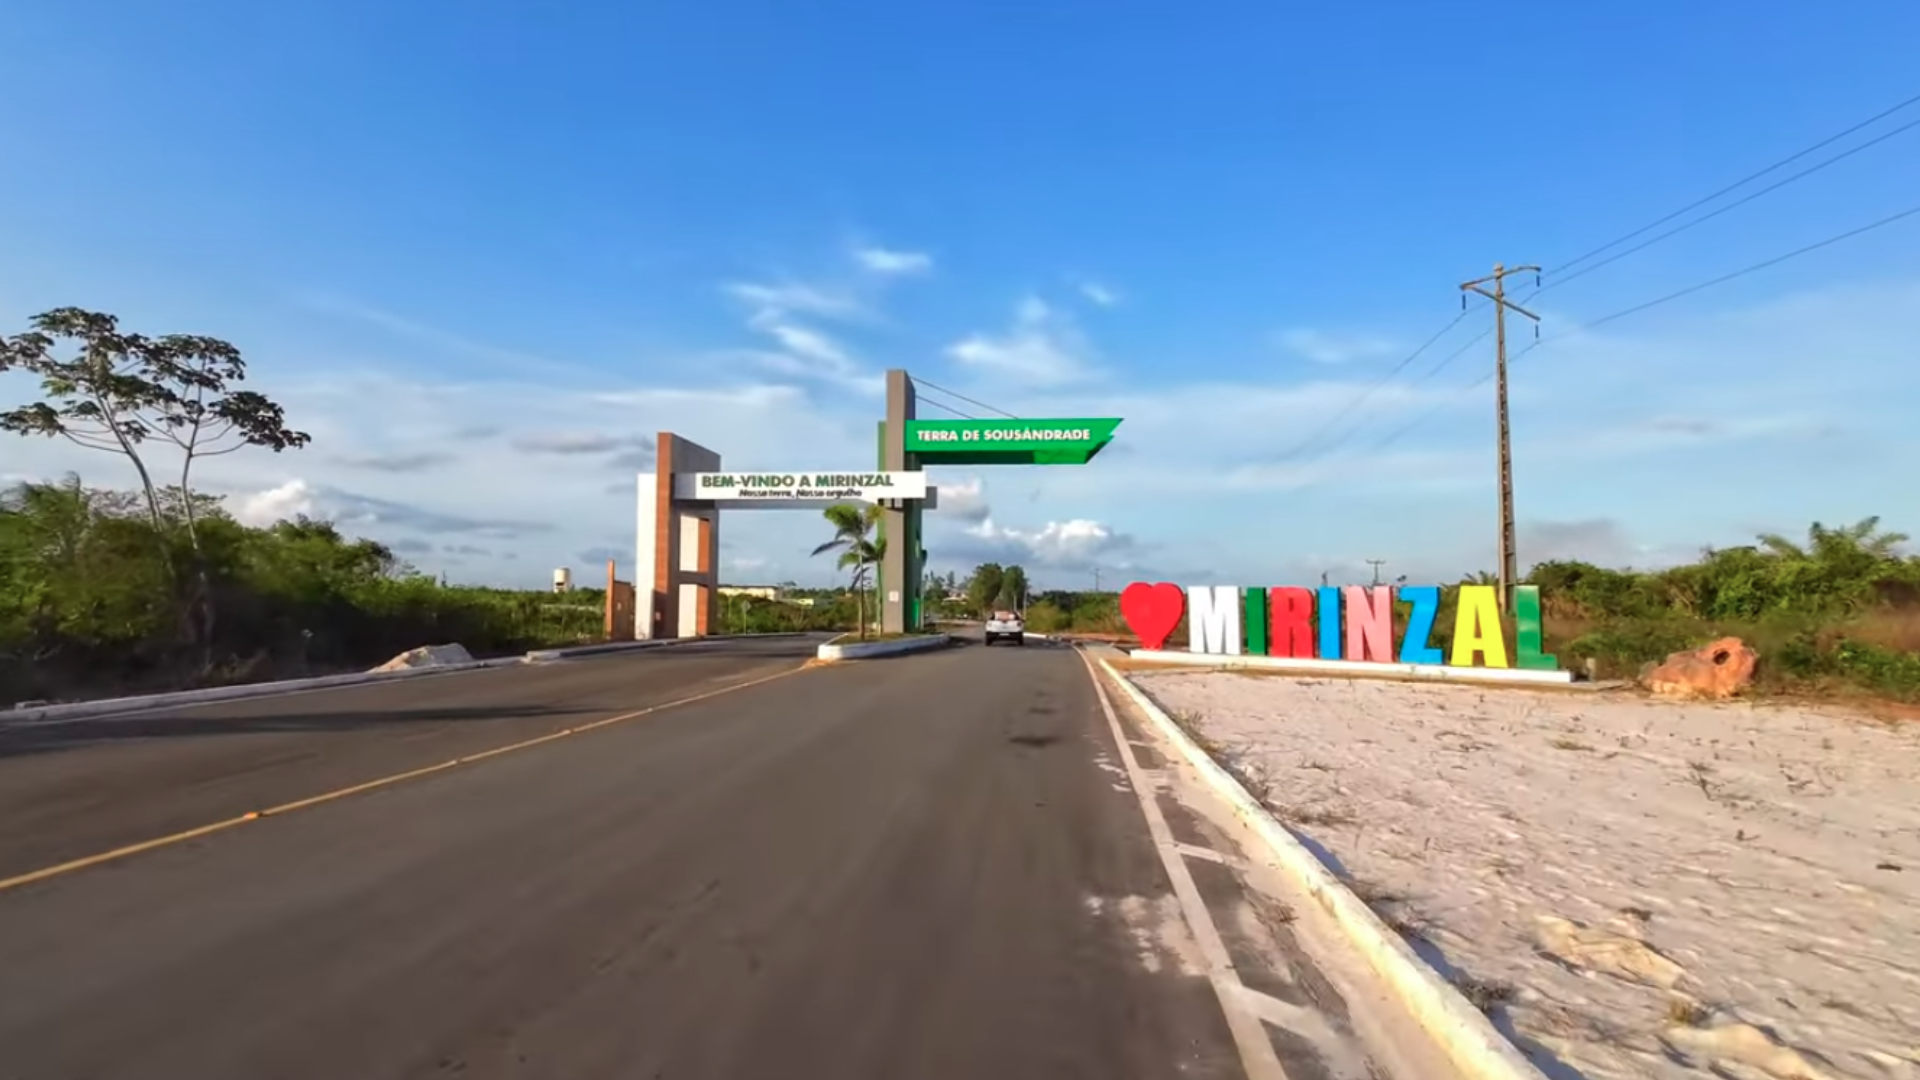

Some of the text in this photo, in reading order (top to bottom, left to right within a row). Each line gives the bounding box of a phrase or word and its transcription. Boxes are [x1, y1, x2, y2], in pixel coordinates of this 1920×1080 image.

[917, 430, 959, 441] TERRA
[962, 430, 980, 441] DE
[702, 475, 894, 487] BEM-VINDO A MIRINZAL
[1188, 585, 1558, 670] MIRINZAL
